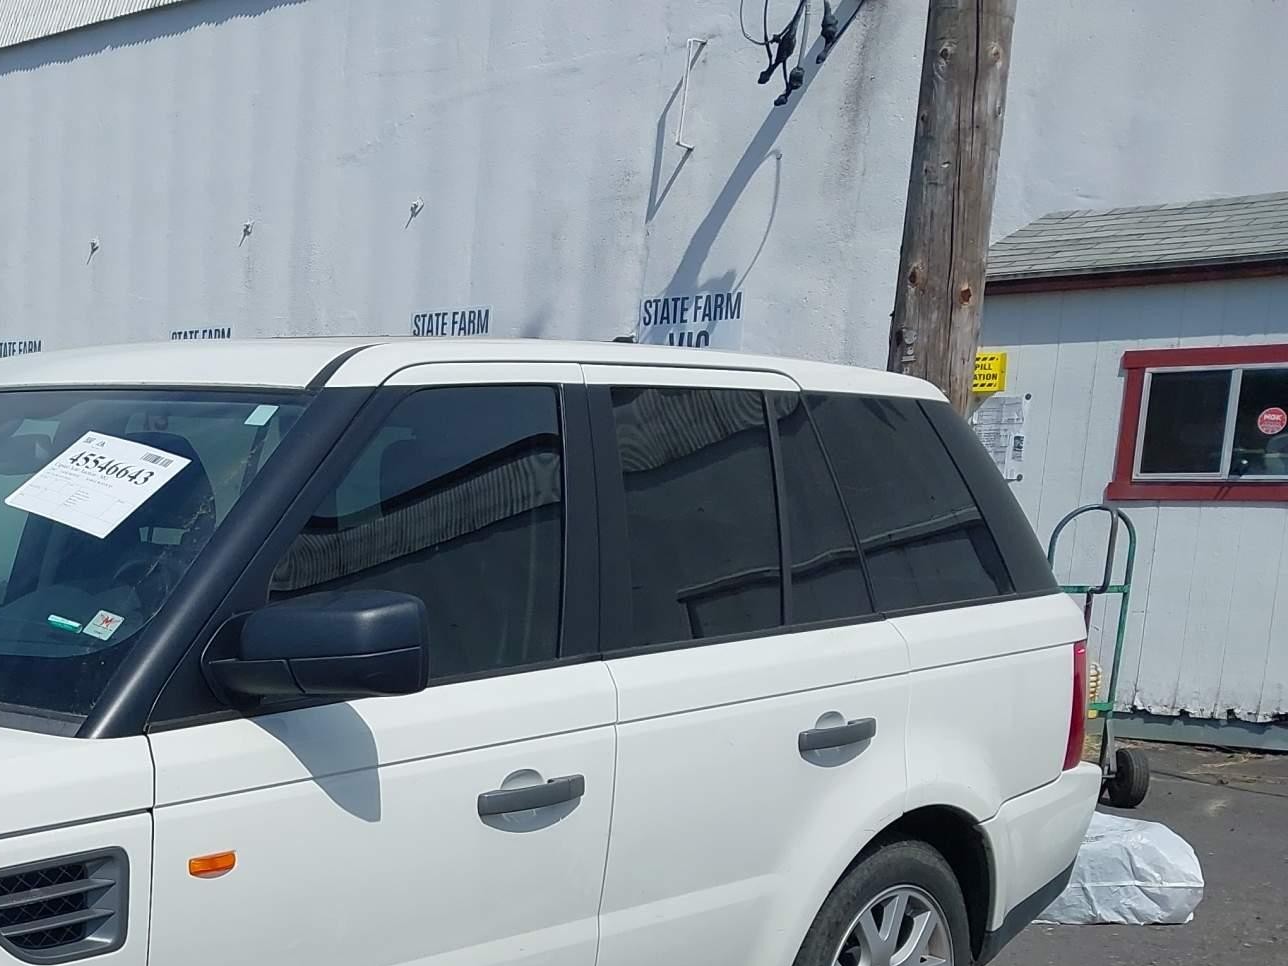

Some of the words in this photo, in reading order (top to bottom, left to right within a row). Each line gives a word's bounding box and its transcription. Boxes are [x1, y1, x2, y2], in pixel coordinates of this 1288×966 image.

[642, 296, 690, 326] STATE
[693, 291, 742, 323] FARM
[412, 311, 448, 336] STATE
[450, 309, 489, 337] FARM
[18, 340, 42, 355] FARM
[973, 373, 998, 381] ATION
[974, 363, 993, 371] PILL
[68, 450, 155, 486] 45546643
